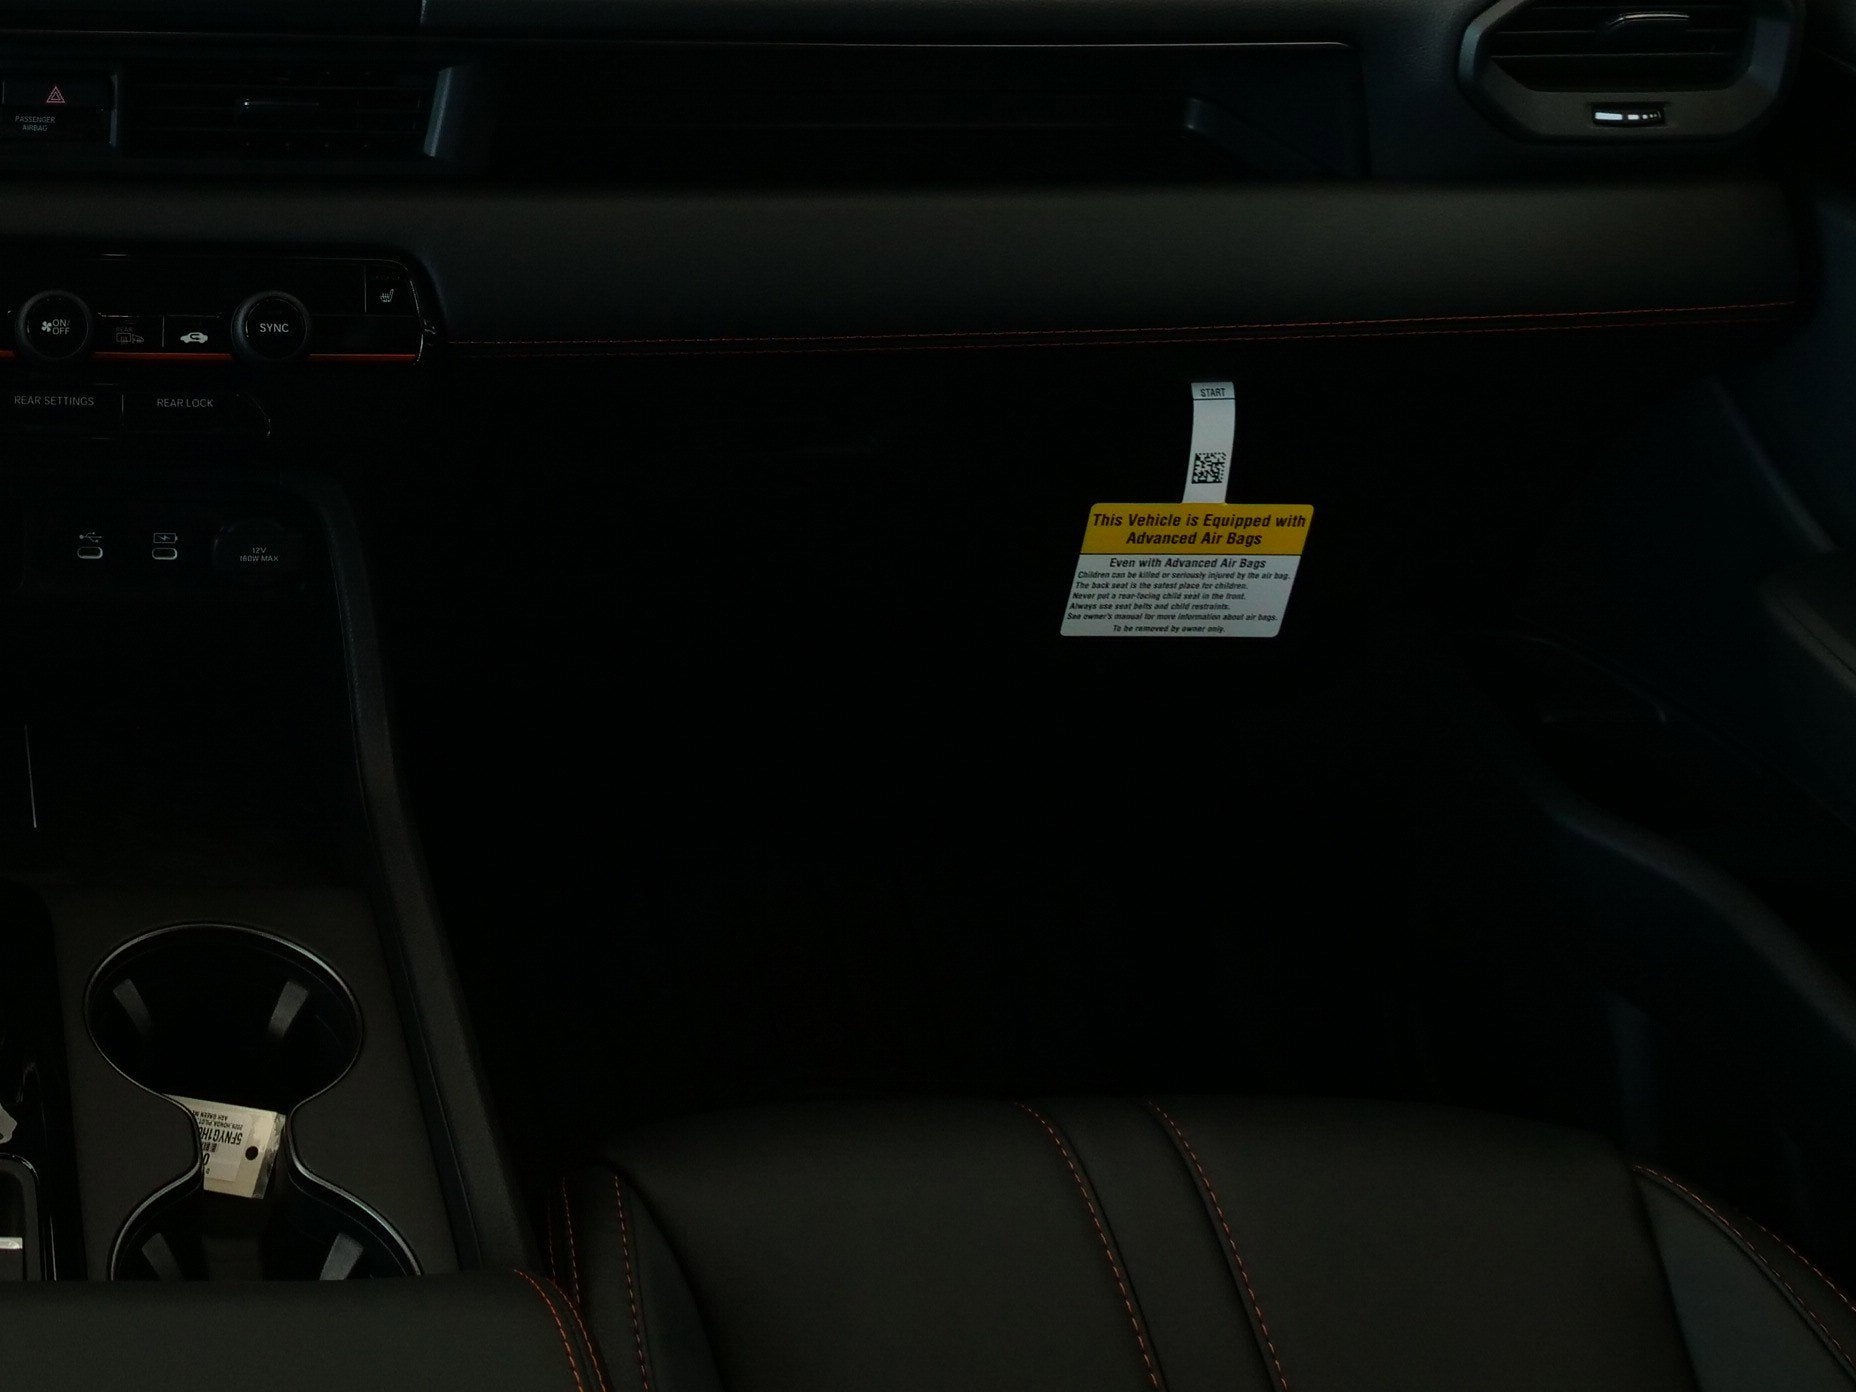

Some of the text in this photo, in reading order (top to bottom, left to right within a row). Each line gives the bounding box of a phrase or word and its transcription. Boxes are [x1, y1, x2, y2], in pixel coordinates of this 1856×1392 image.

[52, 327, 70, 336] OFF
[259, 322, 289, 333] SYNC
[14, 396, 94, 406] REAR SETTINGS
[157, 398, 214, 408] REAR LOCK
[1093, 513, 1306, 529] This Vehicle is Equipped with
[1126, 532, 1262, 547] Advanced Air Bags
[1109, 558, 1266, 570] Even with Advanced Air Bags
